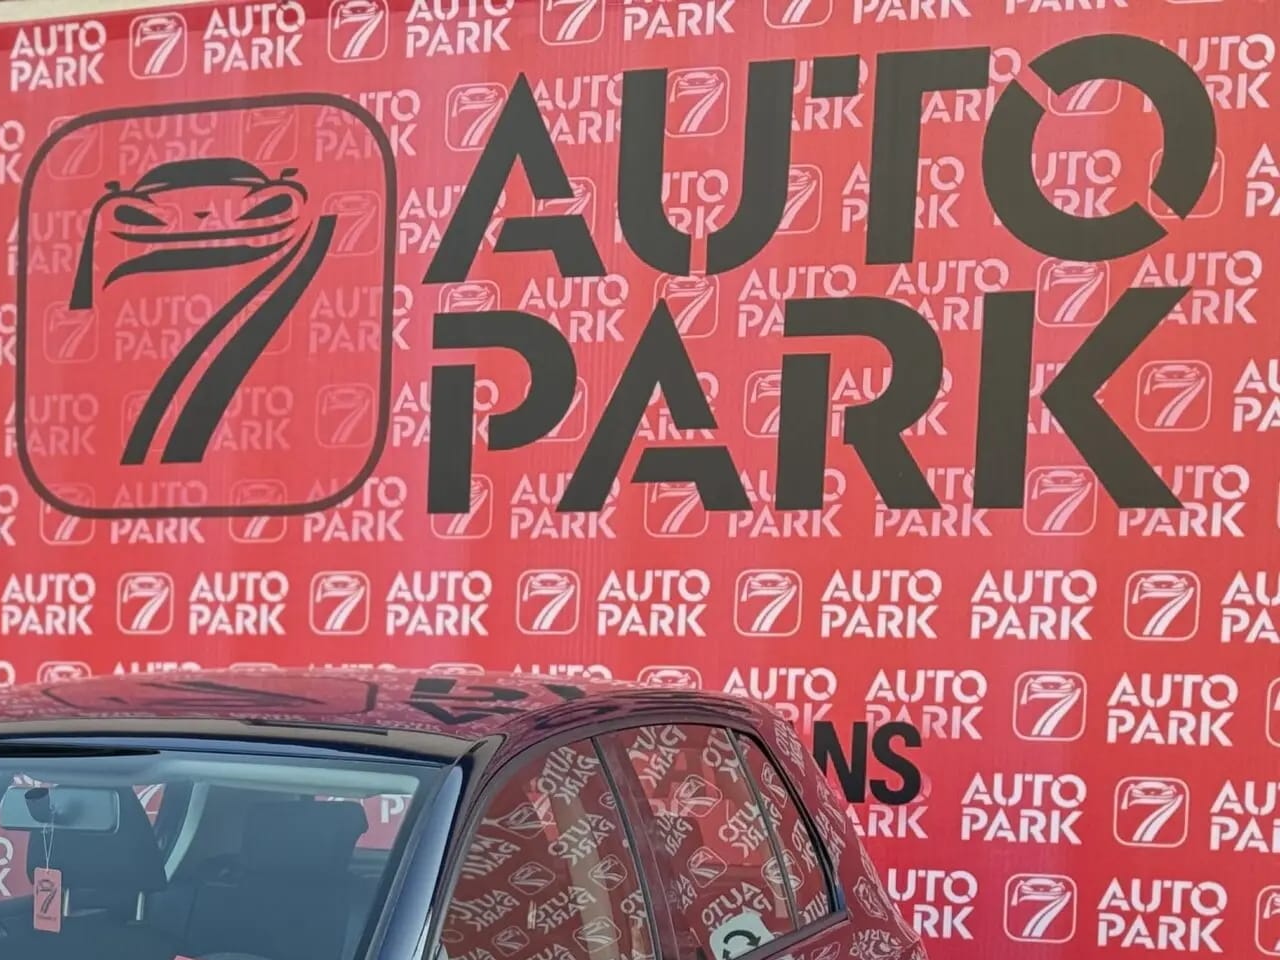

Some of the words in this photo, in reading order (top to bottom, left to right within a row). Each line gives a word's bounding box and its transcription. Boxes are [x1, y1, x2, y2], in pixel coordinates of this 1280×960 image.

[203, 0, 305, 40] AUTO
[406, 18, 510, 57] PARK
[624, 0, 734, 40] PARK
[9, 20, 106, 57] AUTO
[204, 34, 302, 73] PARK
[11, 54, 103, 91] PARK
[422, 33, 1217, 284] AUTO
[1032, 149, 1121, 188] UTO
[739, 265, 857, 302] AUTO
[885, 258, 1010, 297] AUTO
[1130, 251, 1263, 289] AUTO
[517, 274, 629, 310] AUTO
[426, 286, 1192, 514] PARK
[304, 509, 404, 542] PARK
[511, 506, 617, 539] PARK
[728, 504, 842, 537] PARK
[874, 502, 992, 537] PARK
[1119, 502, 1245, 537] PARK
[1, 573, 95, 603] AUTO
[189, 571, 288, 602] AUTO
[386, 571, 492, 602] AUTO
[598, 569, 710, 602] AUTO
[821, 569, 942, 603] AUTO
[971, 569, 1097, 605] AUTO
[1, 604, 92, 635] PARK
[189, 604, 285, 635] PARK
[387, 604, 488, 636] PARK
[598, 604, 706, 636] PARK
[821, 605, 938, 638] PARK
[971, 605, 1093, 640] PARK
[722, 667, 837, 700] AUTO
[865, 669, 987, 704] AUTO
[1107, 672, 1238, 709] AUTO
[1107, 709, 1233, 746] PARK
[961, 772, 1087, 808] AUTO
[961, 807, 1082, 844] PARK
[888, 868, 978, 904] UTO
[1097, 878, 1227, 917] AUTO
[1098, 913, 1223, 952] PARK
